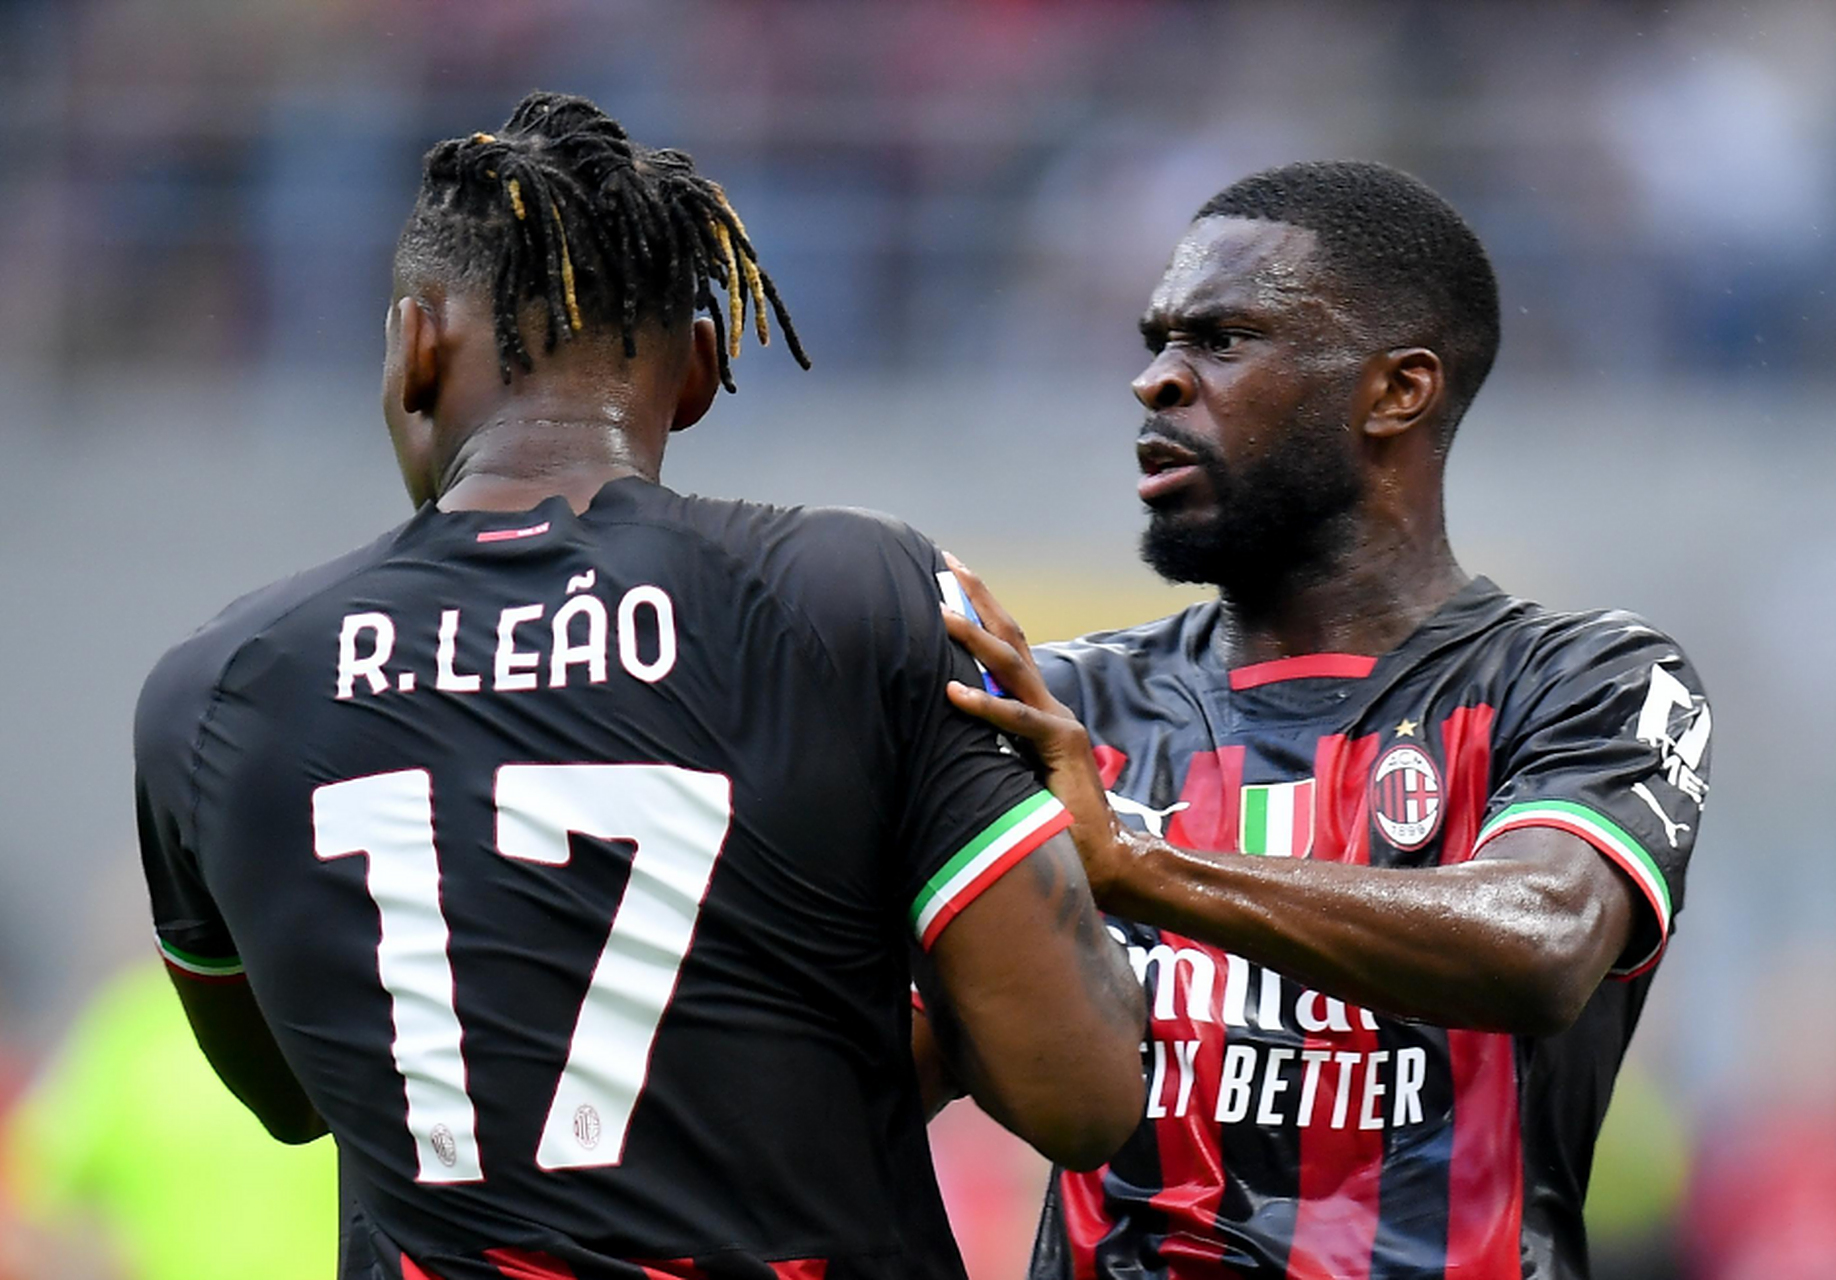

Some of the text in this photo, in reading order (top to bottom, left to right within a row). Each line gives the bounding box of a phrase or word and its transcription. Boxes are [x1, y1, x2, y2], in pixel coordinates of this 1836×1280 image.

[312, 761, 734, 1184] 17
[1139, 1040, 1426, 1131] LY BETTER
